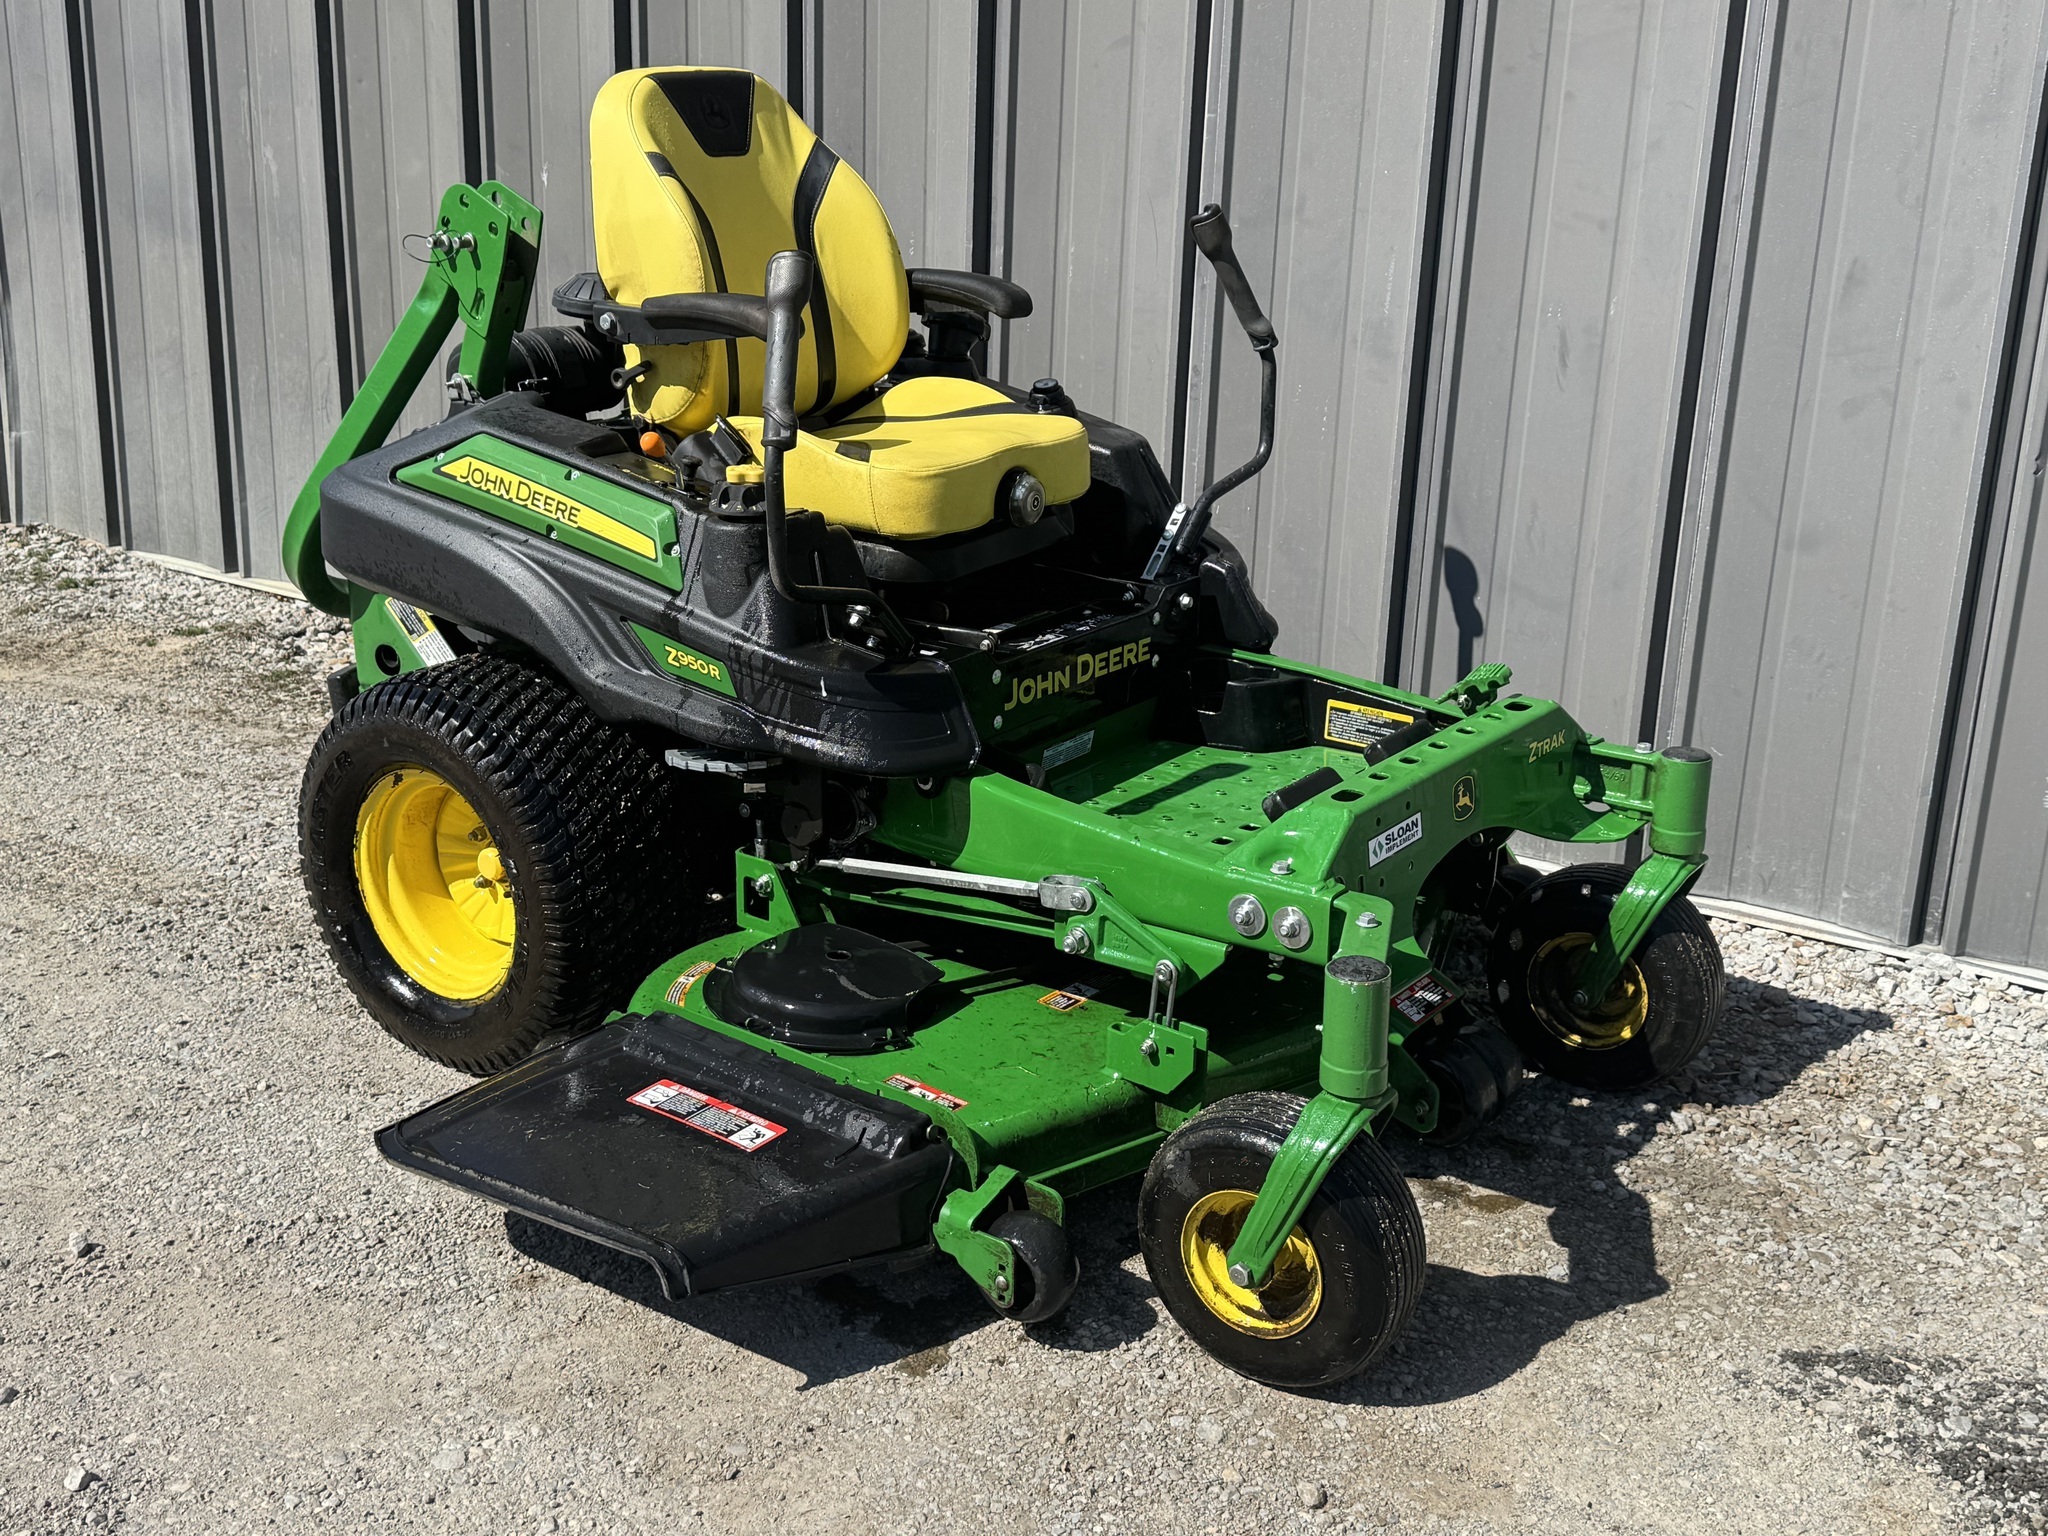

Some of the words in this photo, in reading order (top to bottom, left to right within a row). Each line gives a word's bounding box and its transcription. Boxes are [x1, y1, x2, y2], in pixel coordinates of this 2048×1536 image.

[459, 460, 514, 498] JOHN
[516, 480, 581, 525] DEERE
[664, 646, 721, 681] Z950R
[1005, 665, 1070, 711] JOHN
[1077, 637, 1151, 684] DEERE
[1529, 729, 1566, 763] ZTRAK
[310, 748, 356, 891] MASTER
[1385, 818, 1419, 846] SLOAN
[1385, 829, 1419, 855] IMPLEMENT
